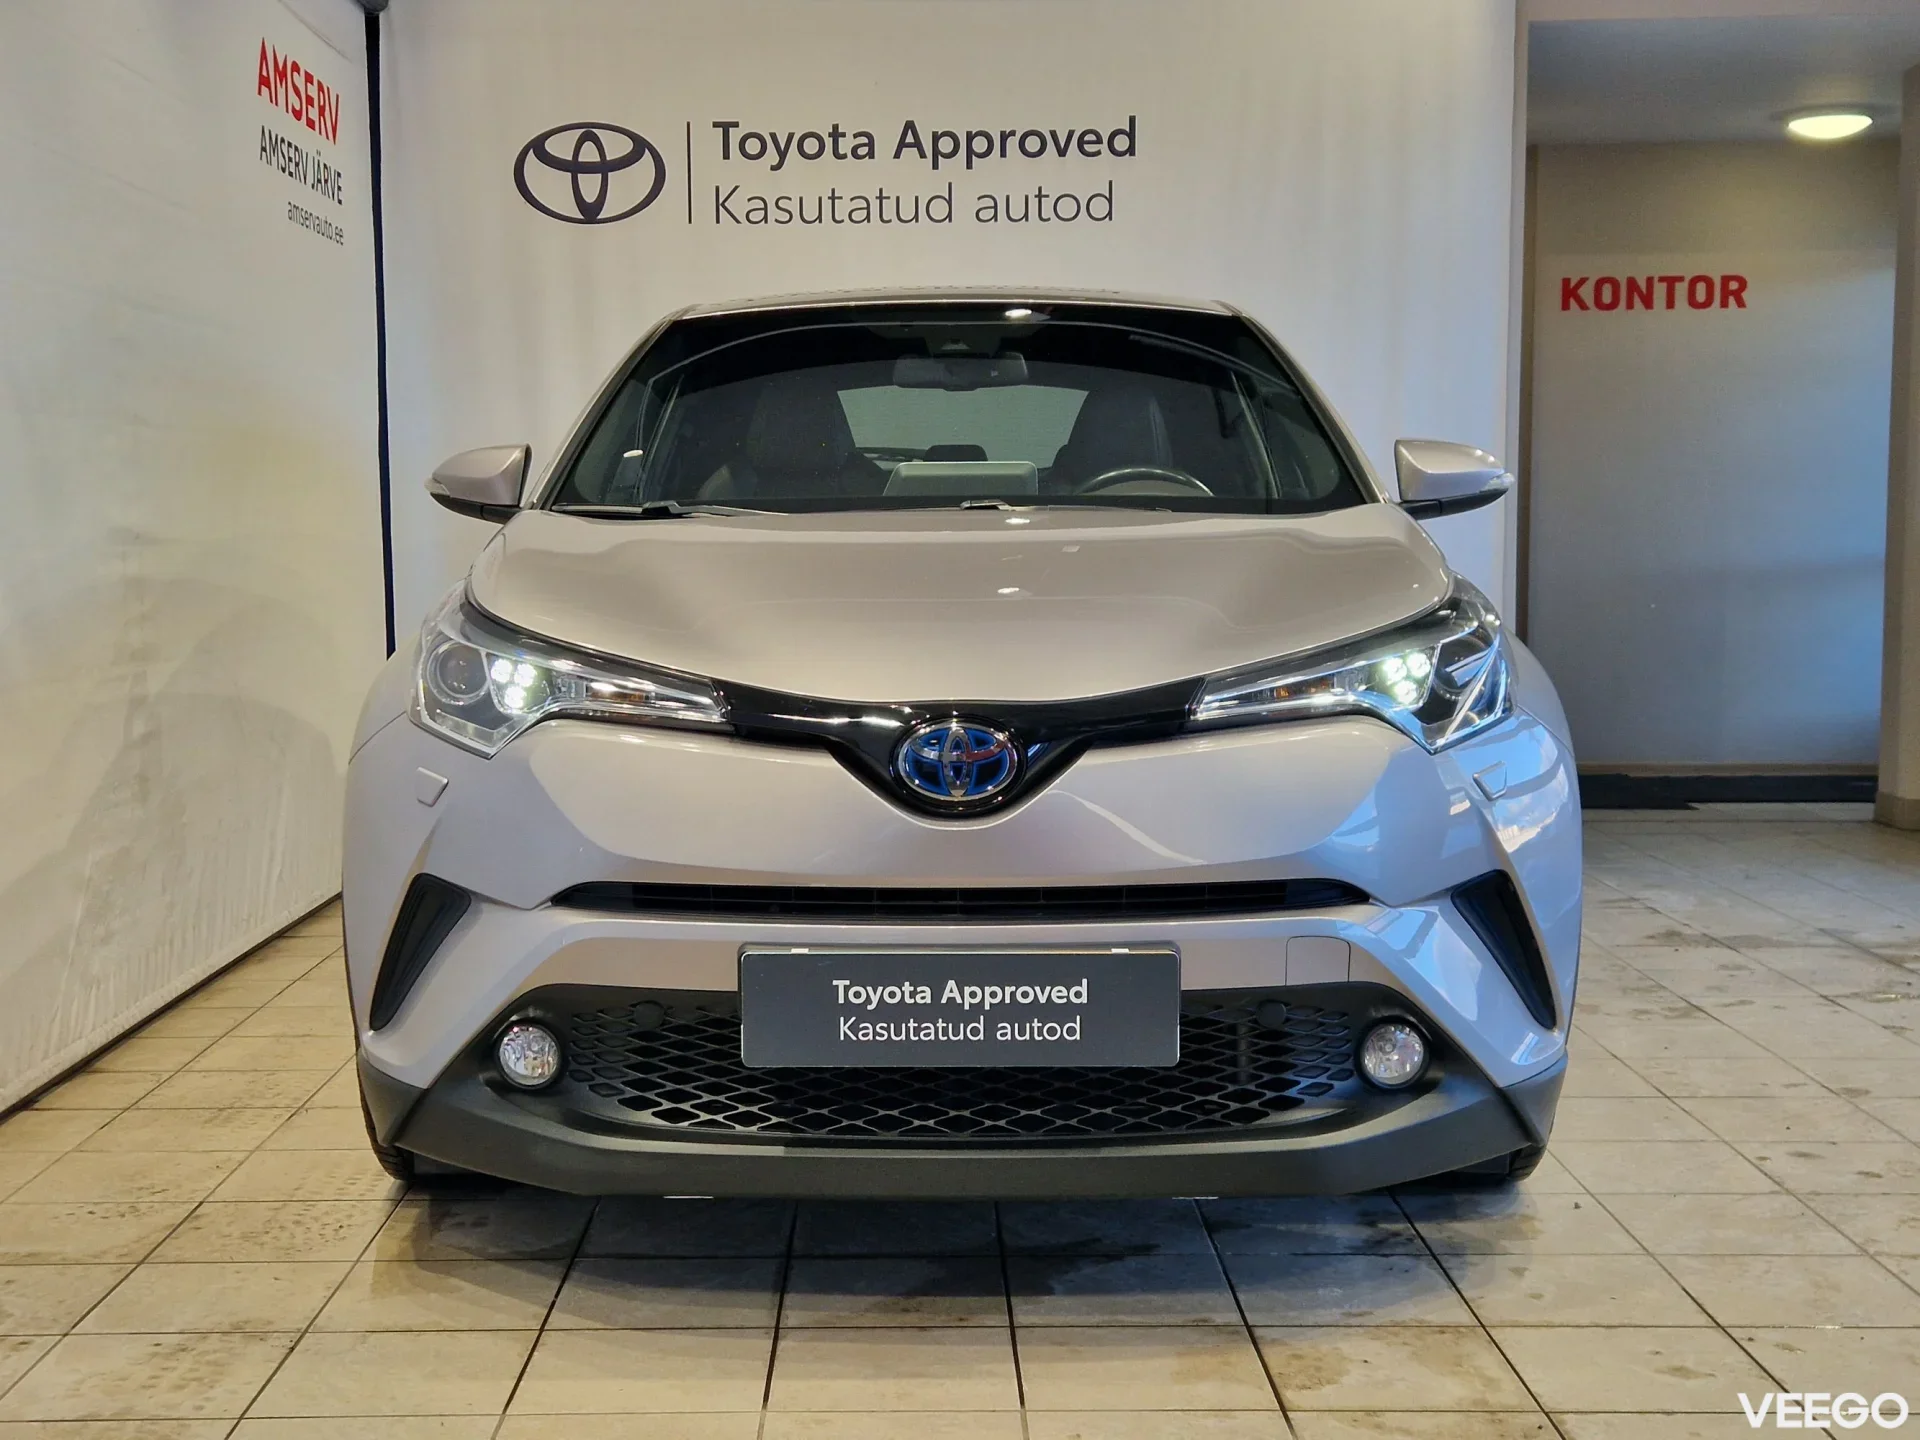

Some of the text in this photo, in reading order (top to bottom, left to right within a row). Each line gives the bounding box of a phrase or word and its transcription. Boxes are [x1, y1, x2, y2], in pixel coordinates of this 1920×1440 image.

[257, 37, 340, 145] AMSERV
[259, 124, 343, 206] AMSERV JÄRVE
[712, 115, 1138, 171] Toyota Approved
[287, 200, 344, 246] amservauto.ee
[713, 180, 1115, 225] Kasutatud autod
[1561, 274, 1748, 311] KONTOR
[832, 978, 1089, 1011] Toyota Approved
[838, 1015, 1082, 1041] Kasutatud autod
